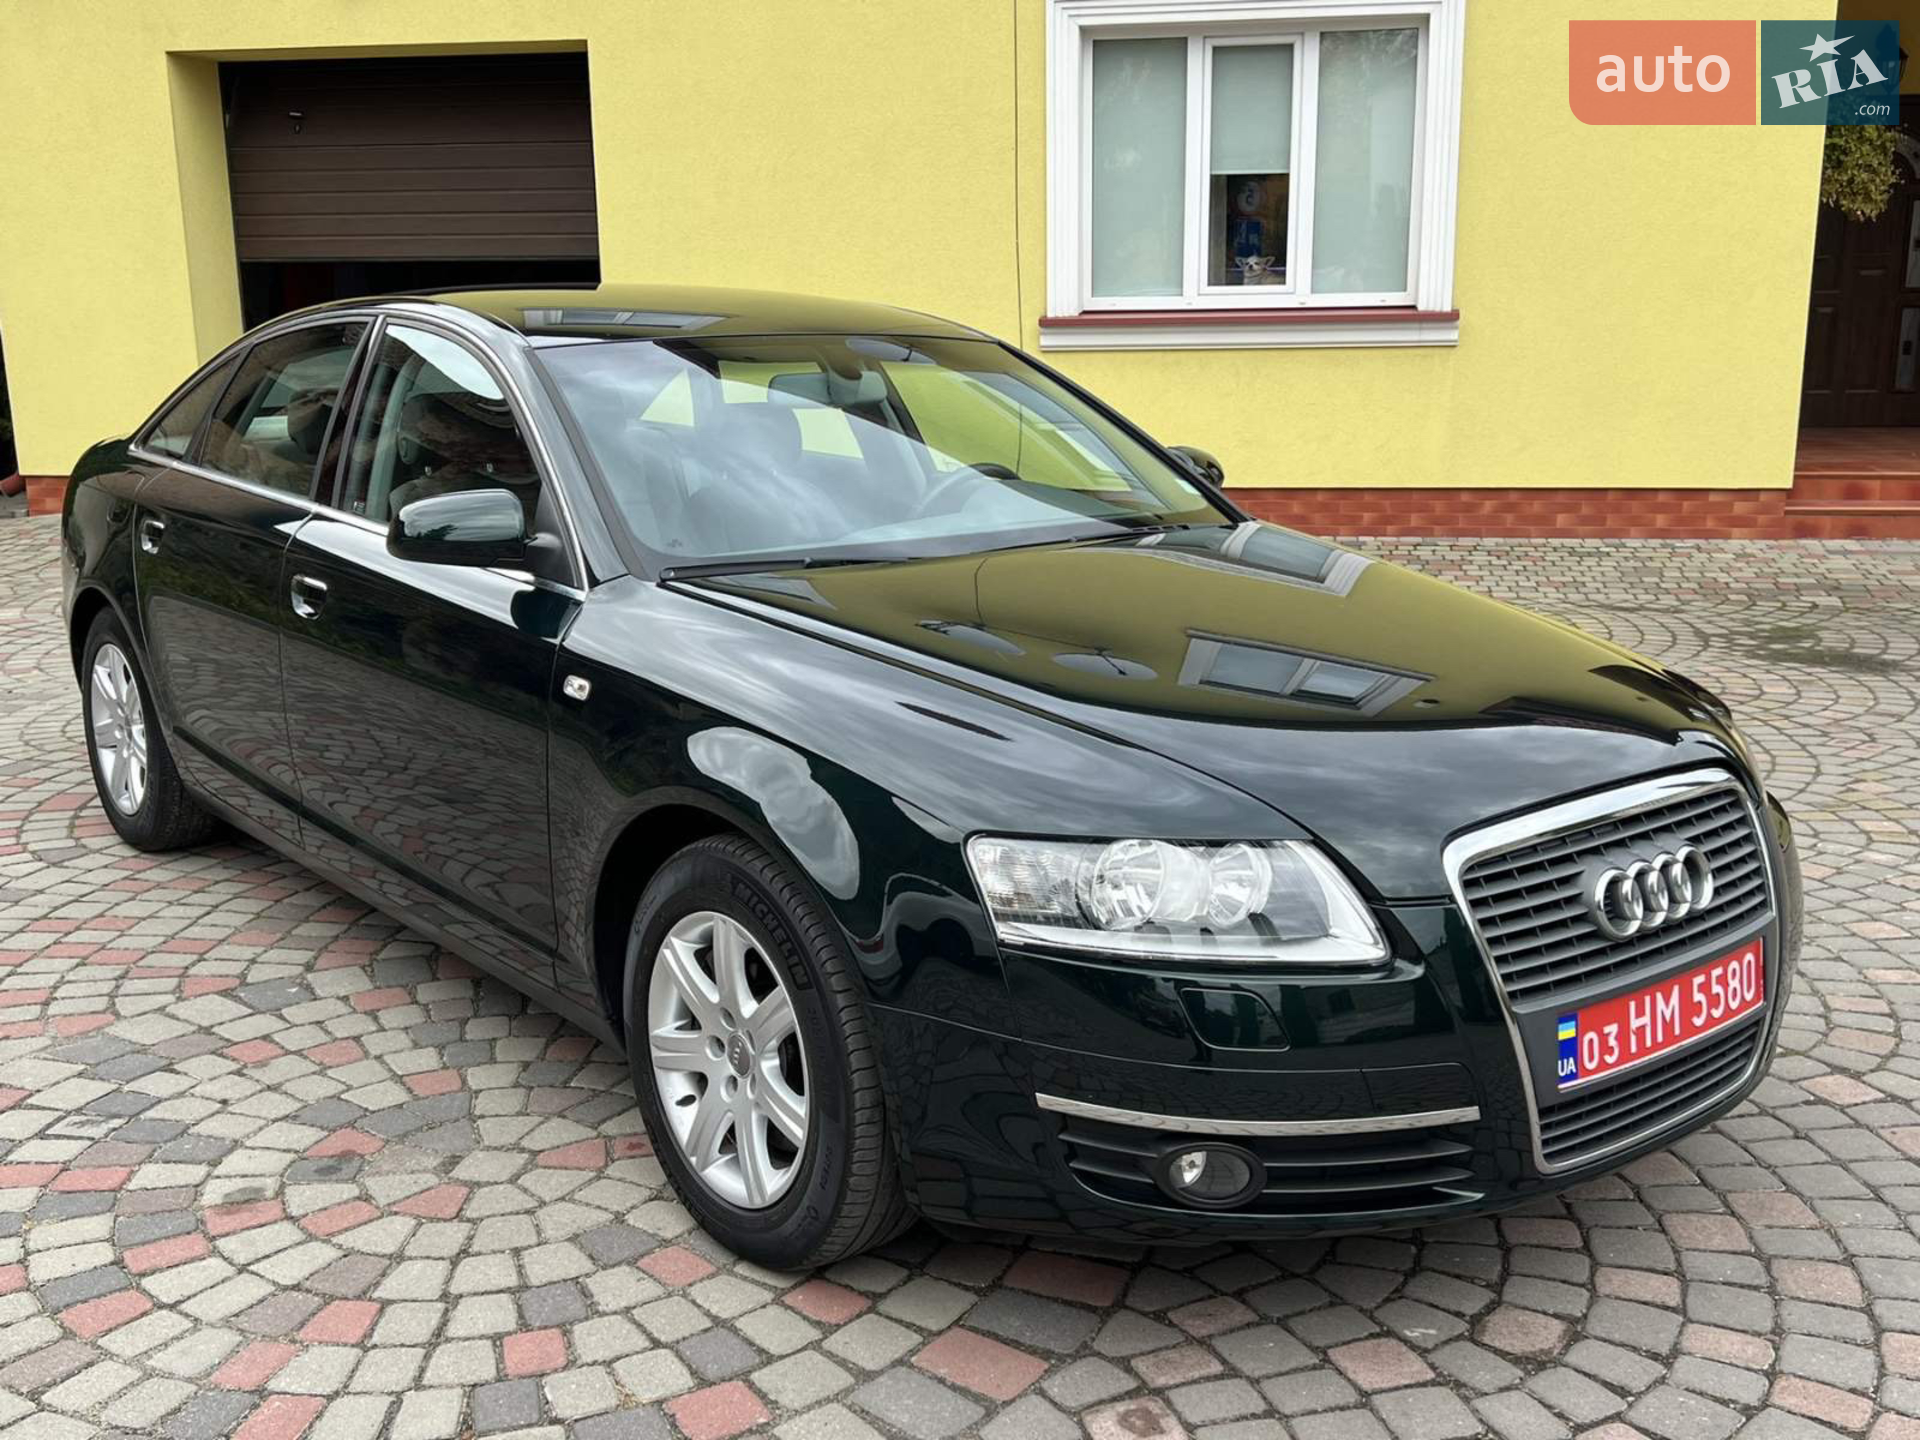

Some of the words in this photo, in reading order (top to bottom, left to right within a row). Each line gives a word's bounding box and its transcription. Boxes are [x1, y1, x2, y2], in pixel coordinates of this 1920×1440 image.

[732, 880, 811, 988] MICHELIN
[1582, 1023, 1619, 1071] 03
[1629, 984, 1681, 1054] HM
[1691, 952, 1756, 1028] 5580
[1557, 1056, 1577, 1077] UA
